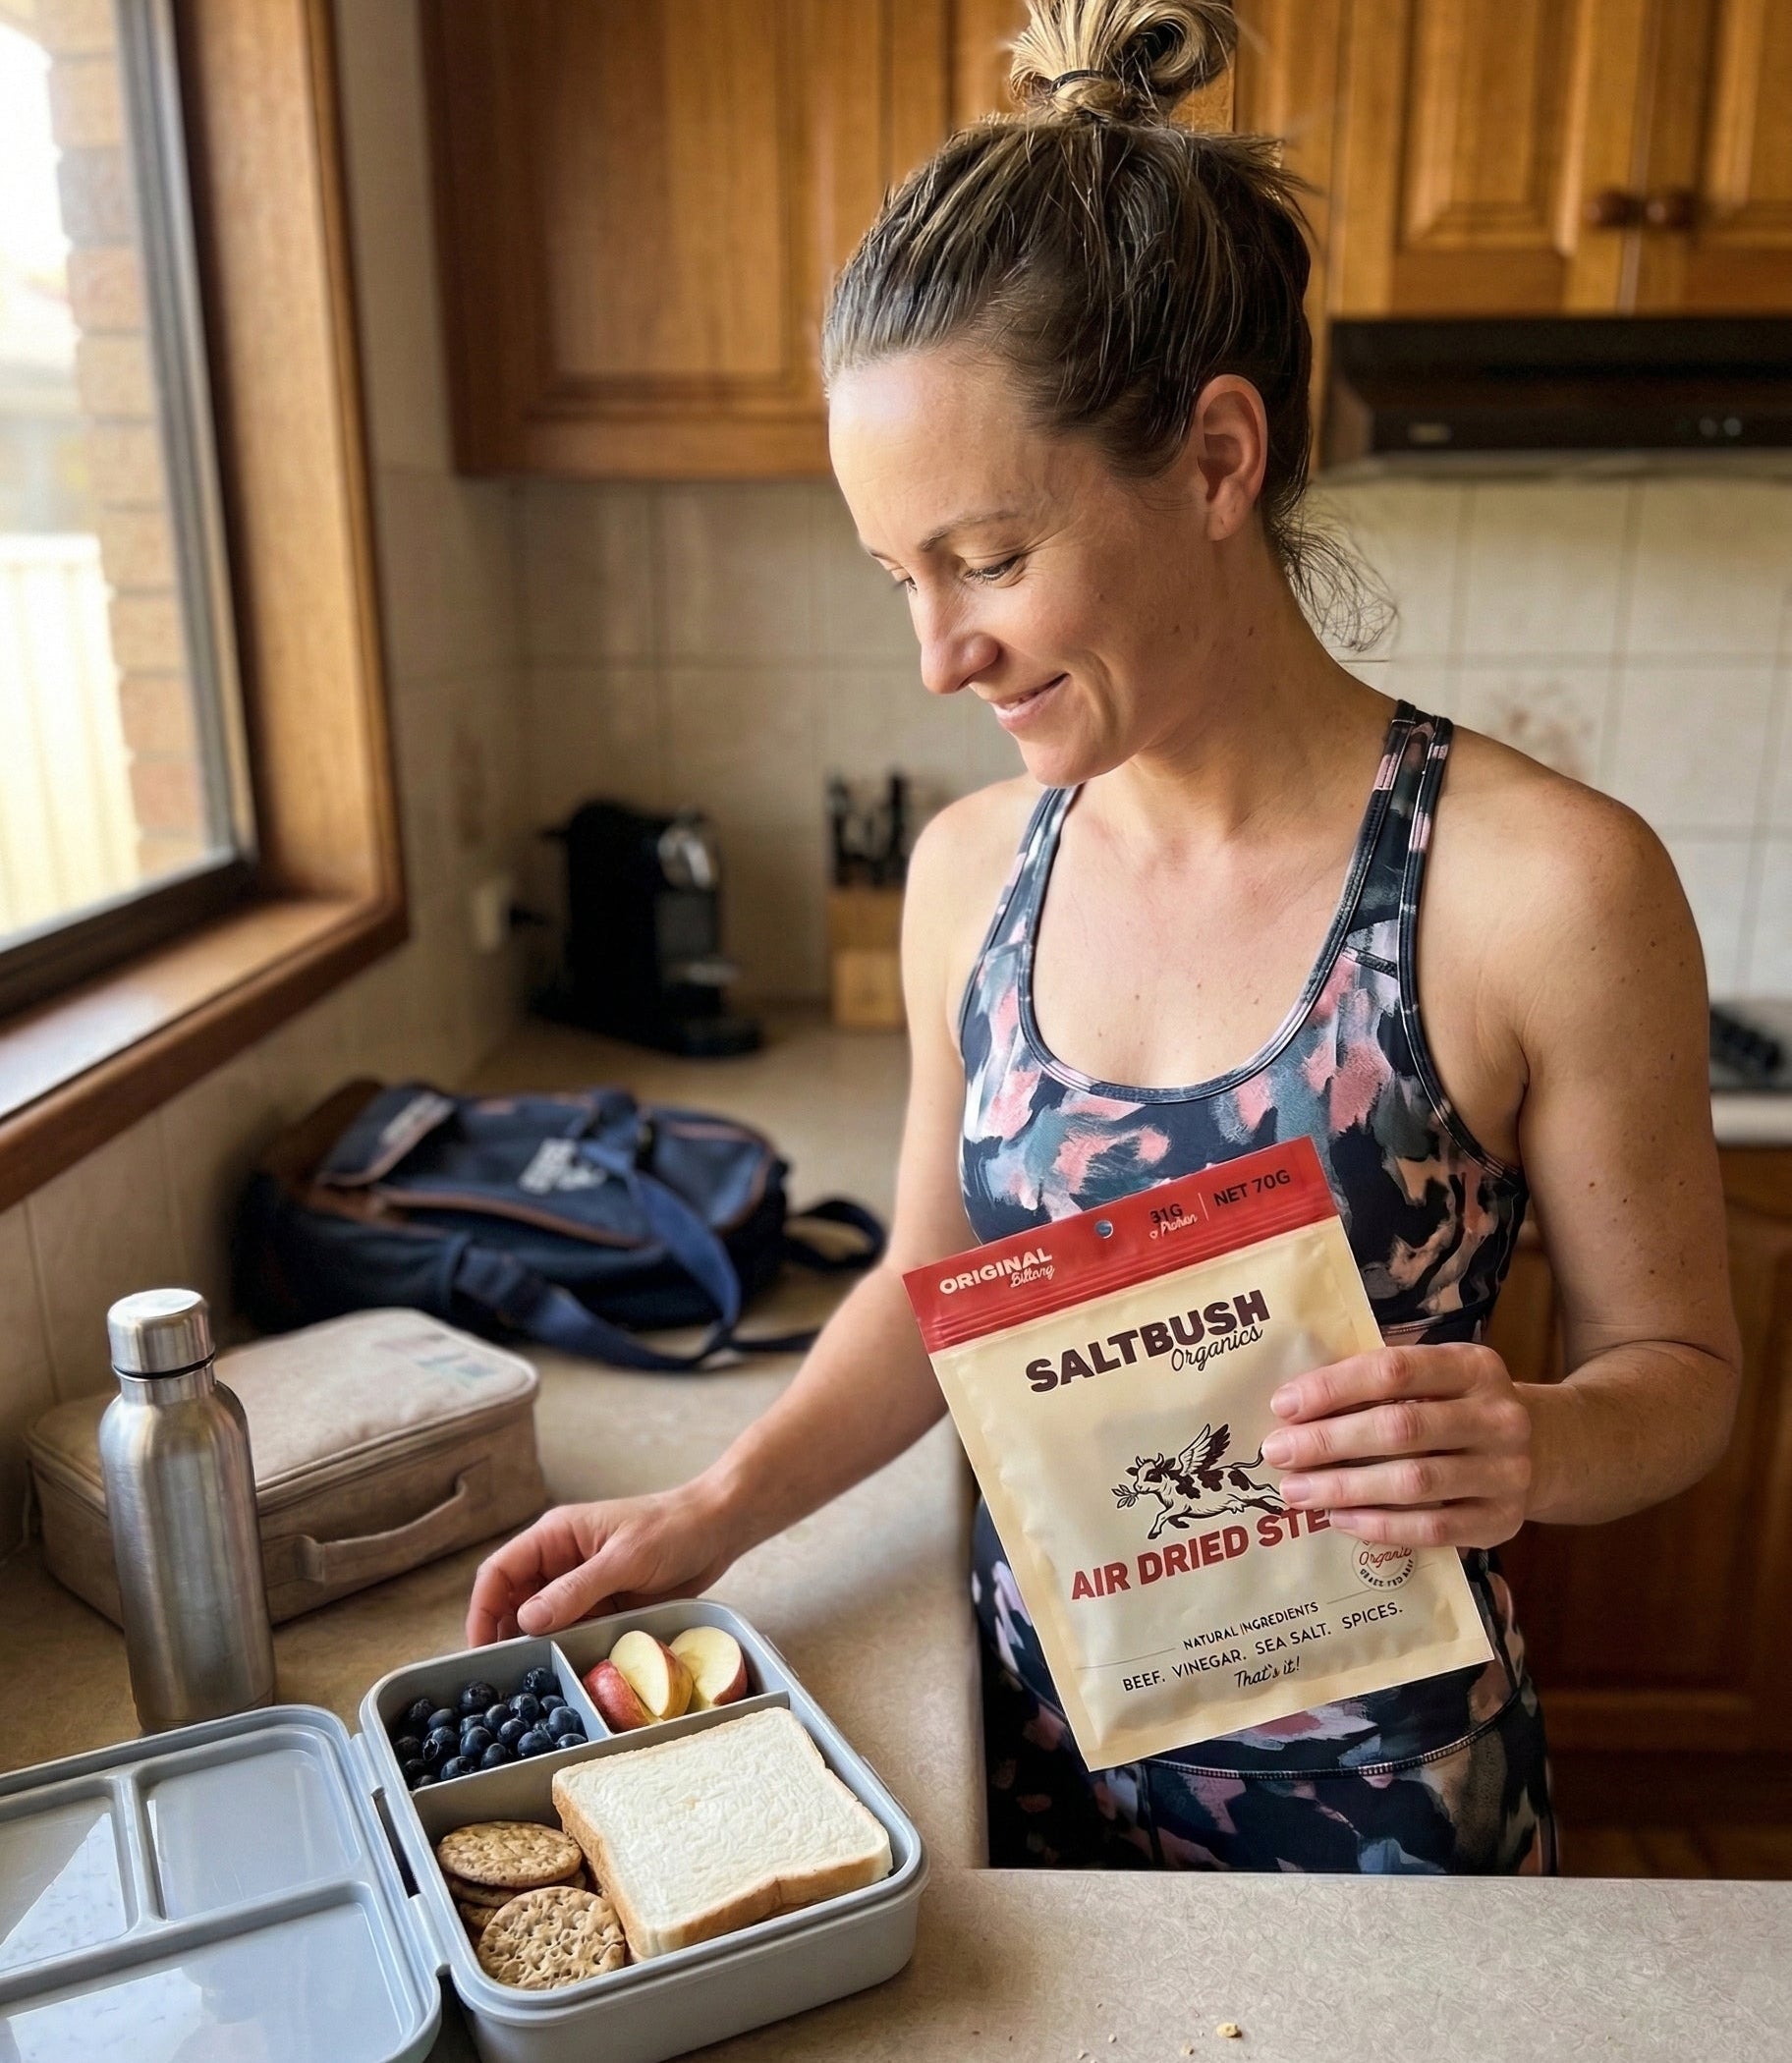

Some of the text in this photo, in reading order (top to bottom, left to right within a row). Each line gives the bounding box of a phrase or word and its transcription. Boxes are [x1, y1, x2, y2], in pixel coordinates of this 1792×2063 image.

[1213, 1169, 1291, 1207] NET 70G
[1149, 1203, 1184, 1224] 31G
[938, 1248, 1053, 1295] ORIGINAL
[1026, 1289, 1270, 1393] SALTBUSH
[1171, 1324, 1264, 1372] Organics
[1071, 1508, 1331, 1601] AIR DRIED STE
[1122, 1602, 1404, 1692] BEEF. VINEGAR. SEA SALT. SPICES.
[1183, 1601, 1319, 1650] NATURAL INGREDIENTS
[1234, 1656, 1301, 1689] That's it!
